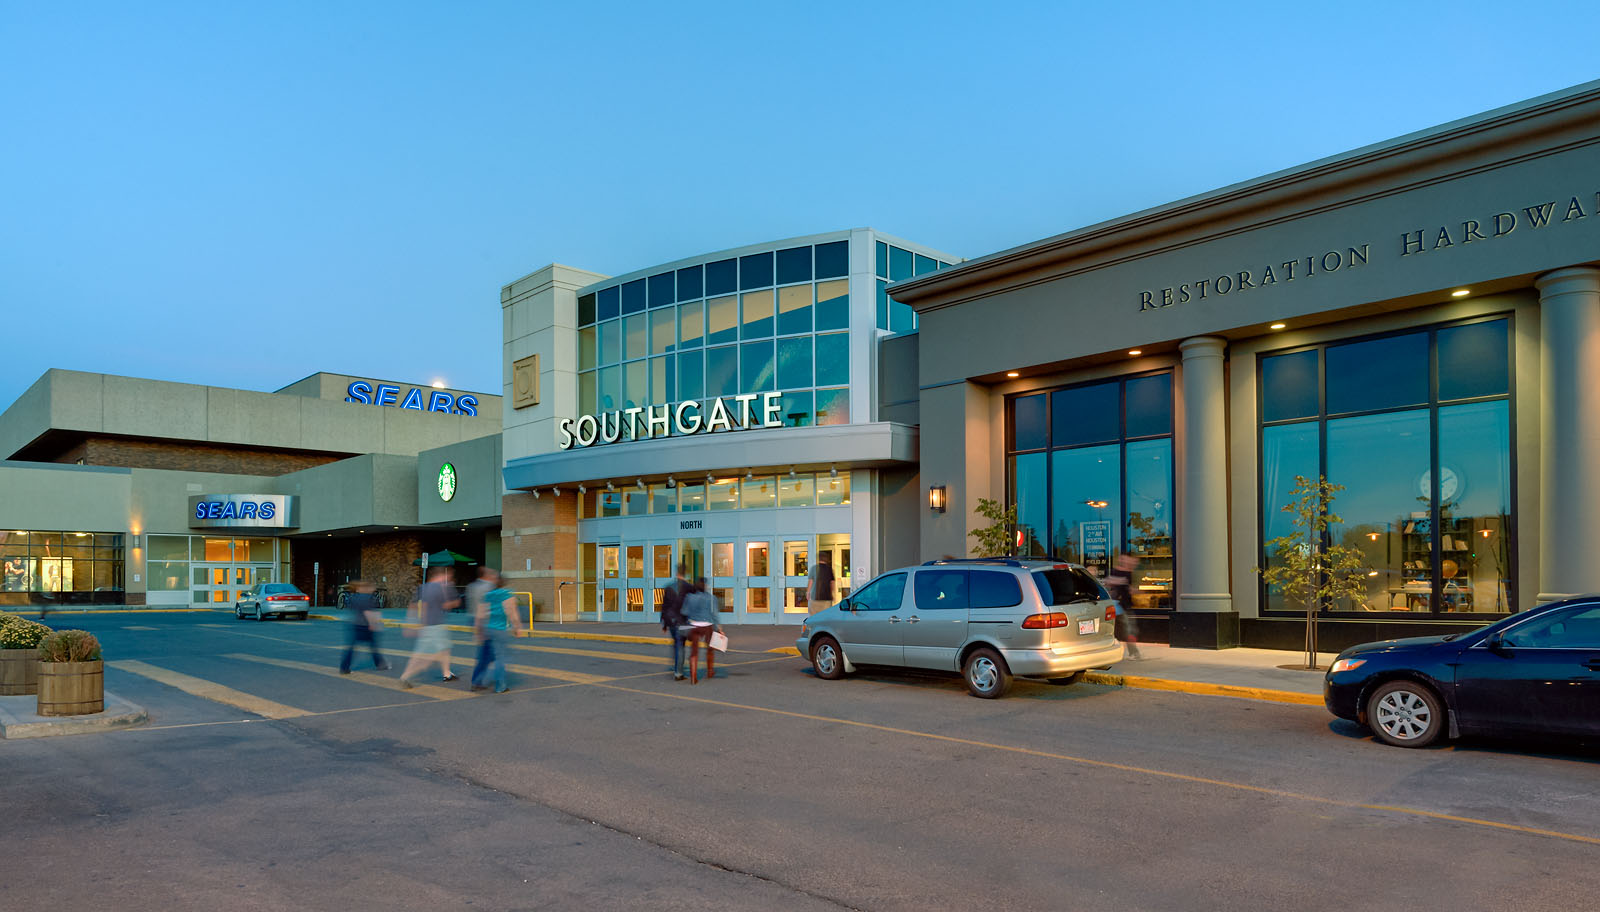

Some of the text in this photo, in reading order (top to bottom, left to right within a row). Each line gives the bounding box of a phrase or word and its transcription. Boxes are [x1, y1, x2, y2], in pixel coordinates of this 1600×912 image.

[1139, 244, 1369, 312] RESTORATION
[345, 381, 478, 416] SEARS
[559, 391, 784, 450] SOUTHGATE
[196, 501, 276, 520] SEARS
[680, 520, 703, 530] NORTH
